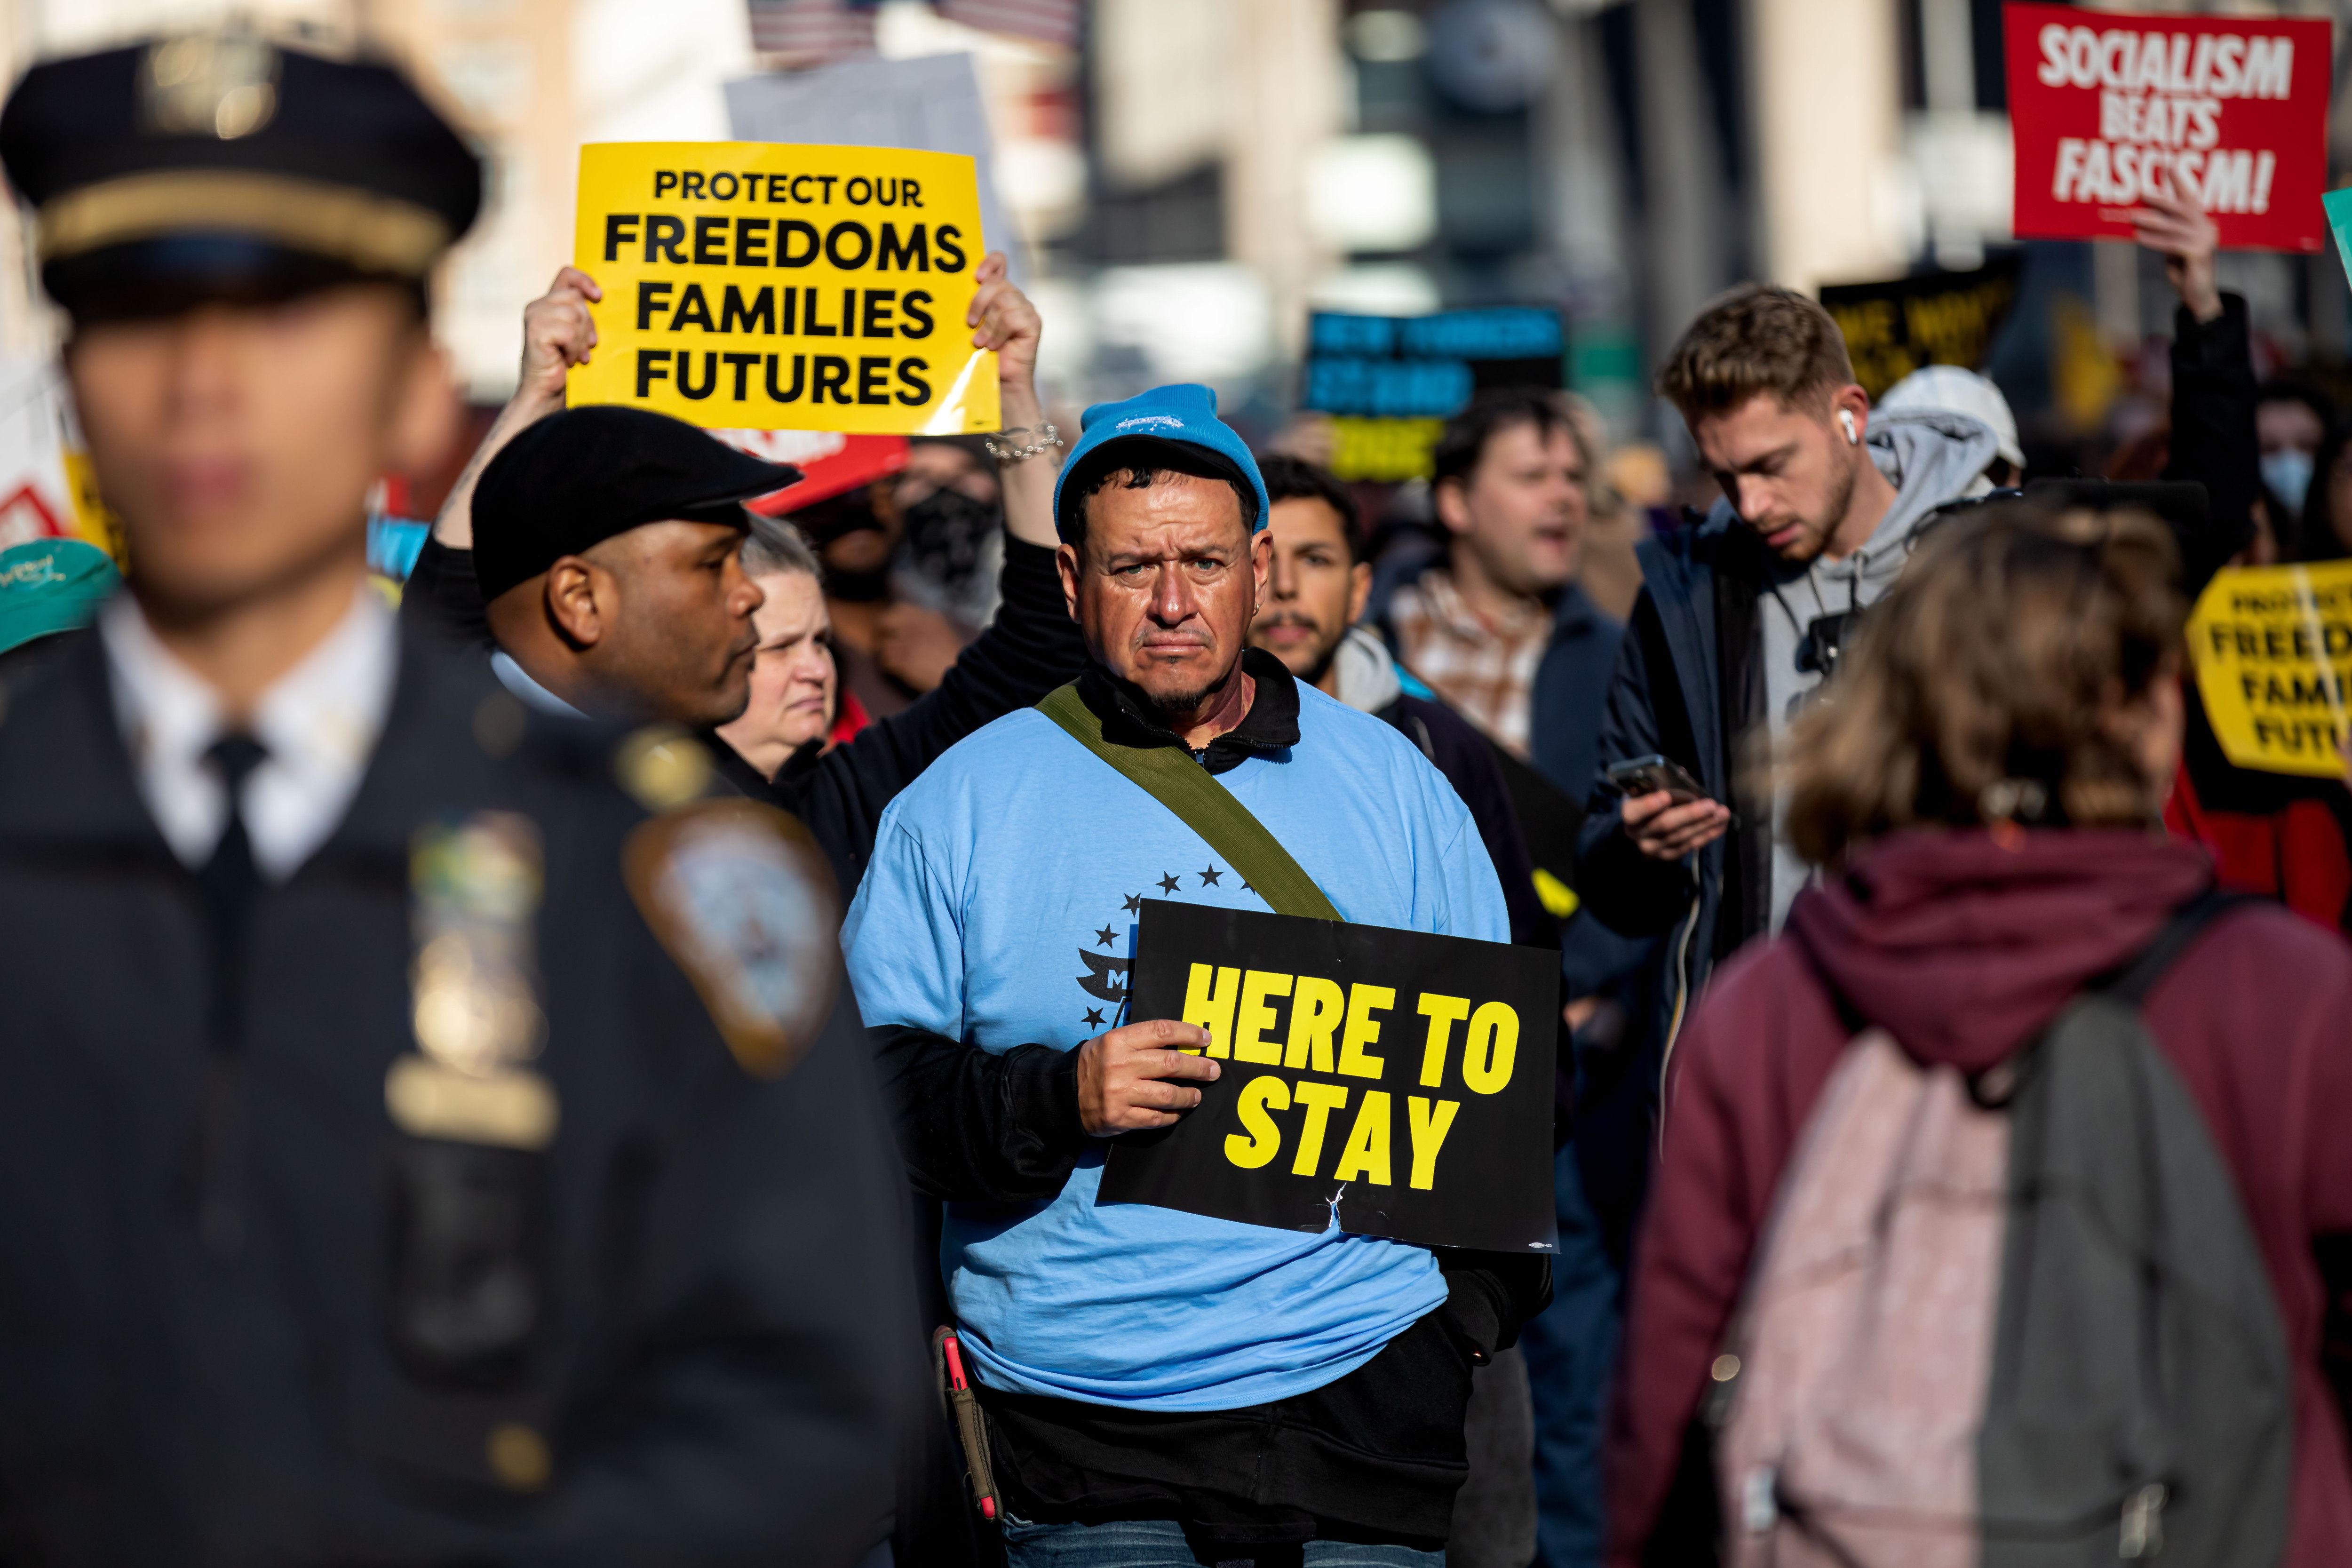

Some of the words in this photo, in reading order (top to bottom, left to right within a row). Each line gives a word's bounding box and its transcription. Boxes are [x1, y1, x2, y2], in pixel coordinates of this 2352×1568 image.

[2037, 24, 2295, 100] SOCIALISM
[2099, 88, 2222, 150] BEATS
[655, 171, 838, 204] PROTECT
[846, 177, 923, 207] OUR
[604, 214, 966, 274] FREEDOMS
[636, 281, 935, 340] FAMILIES
[636, 349, 932, 406] FUTURES
[2241, 670, 2352, 706] FAMI
[1177, 963, 1396, 1080] HERE
[1417, 992, 1519, 1095] TO
[1224, 1075, 1461, 1190] STAY
